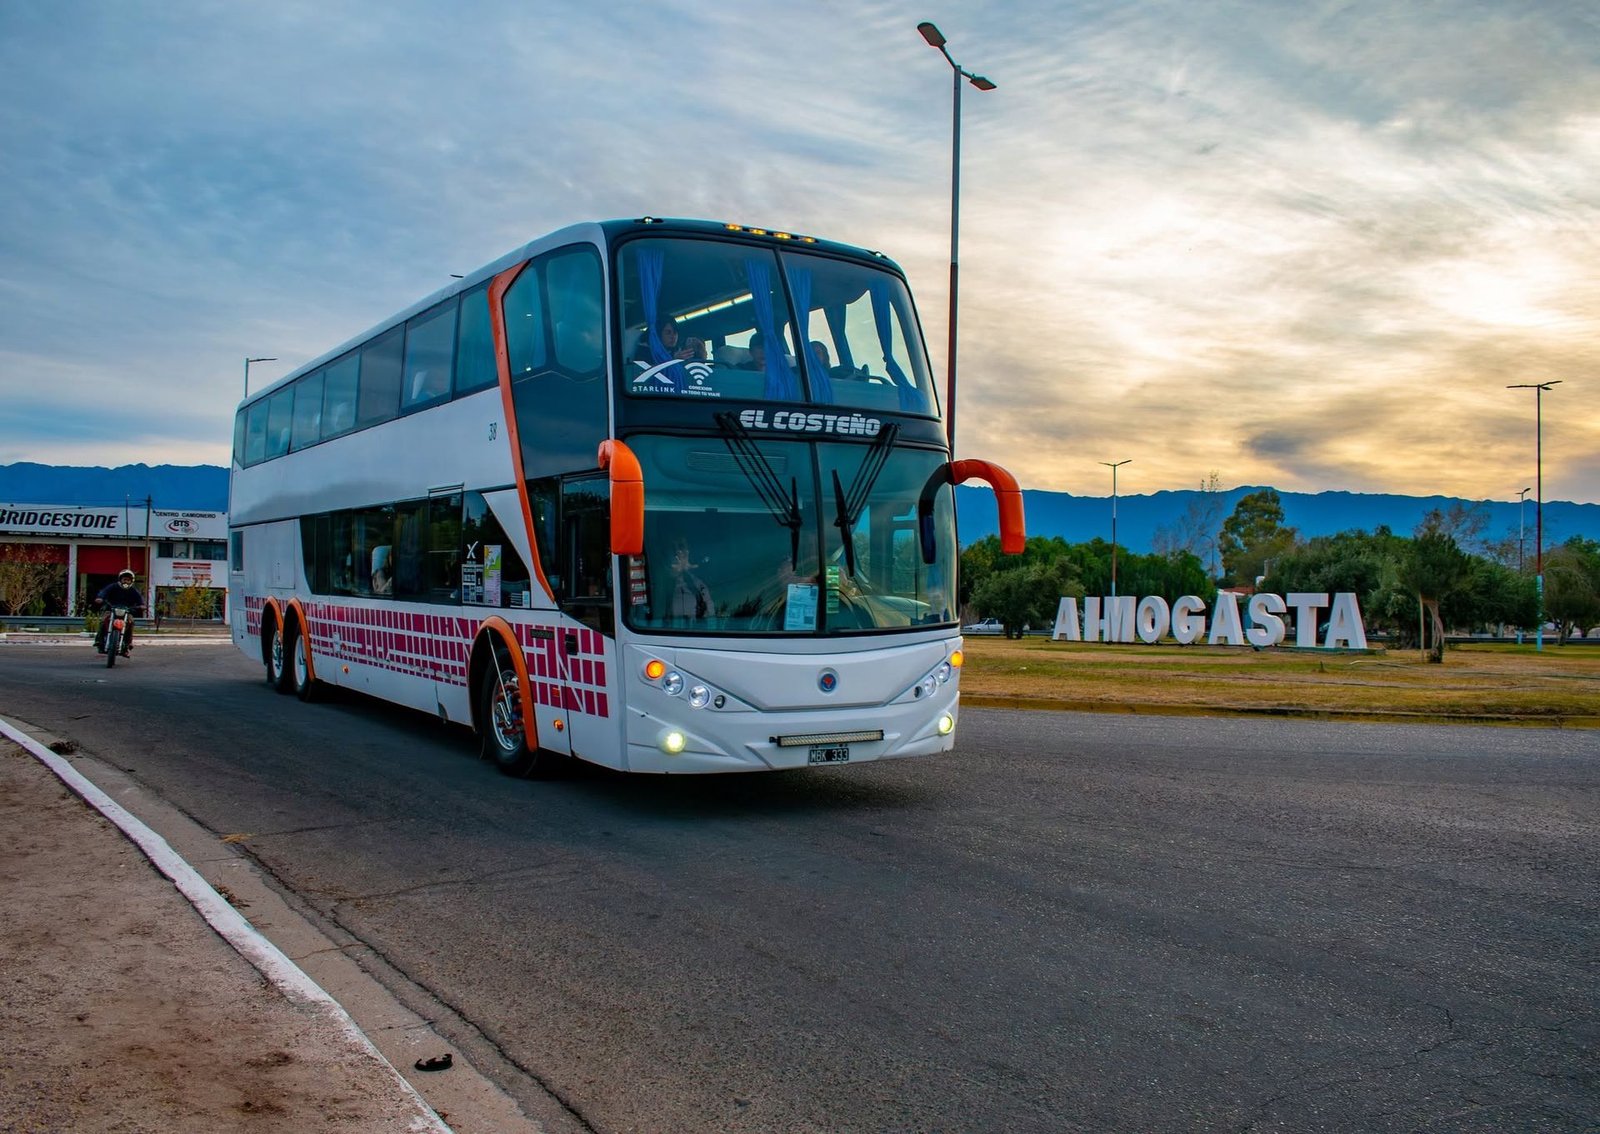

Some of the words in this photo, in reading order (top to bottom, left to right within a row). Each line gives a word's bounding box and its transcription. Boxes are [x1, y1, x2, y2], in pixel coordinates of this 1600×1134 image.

[739, 409, 769, 429] EL
[773, 411, 881, 436] COSTEÑO
[173, 519, 190, 527] BTS
[1052, 592, 1368, 649] AIMOGASTA
[810, 750, 827, 762] MBK
[831, 749, 848, 761] 333
